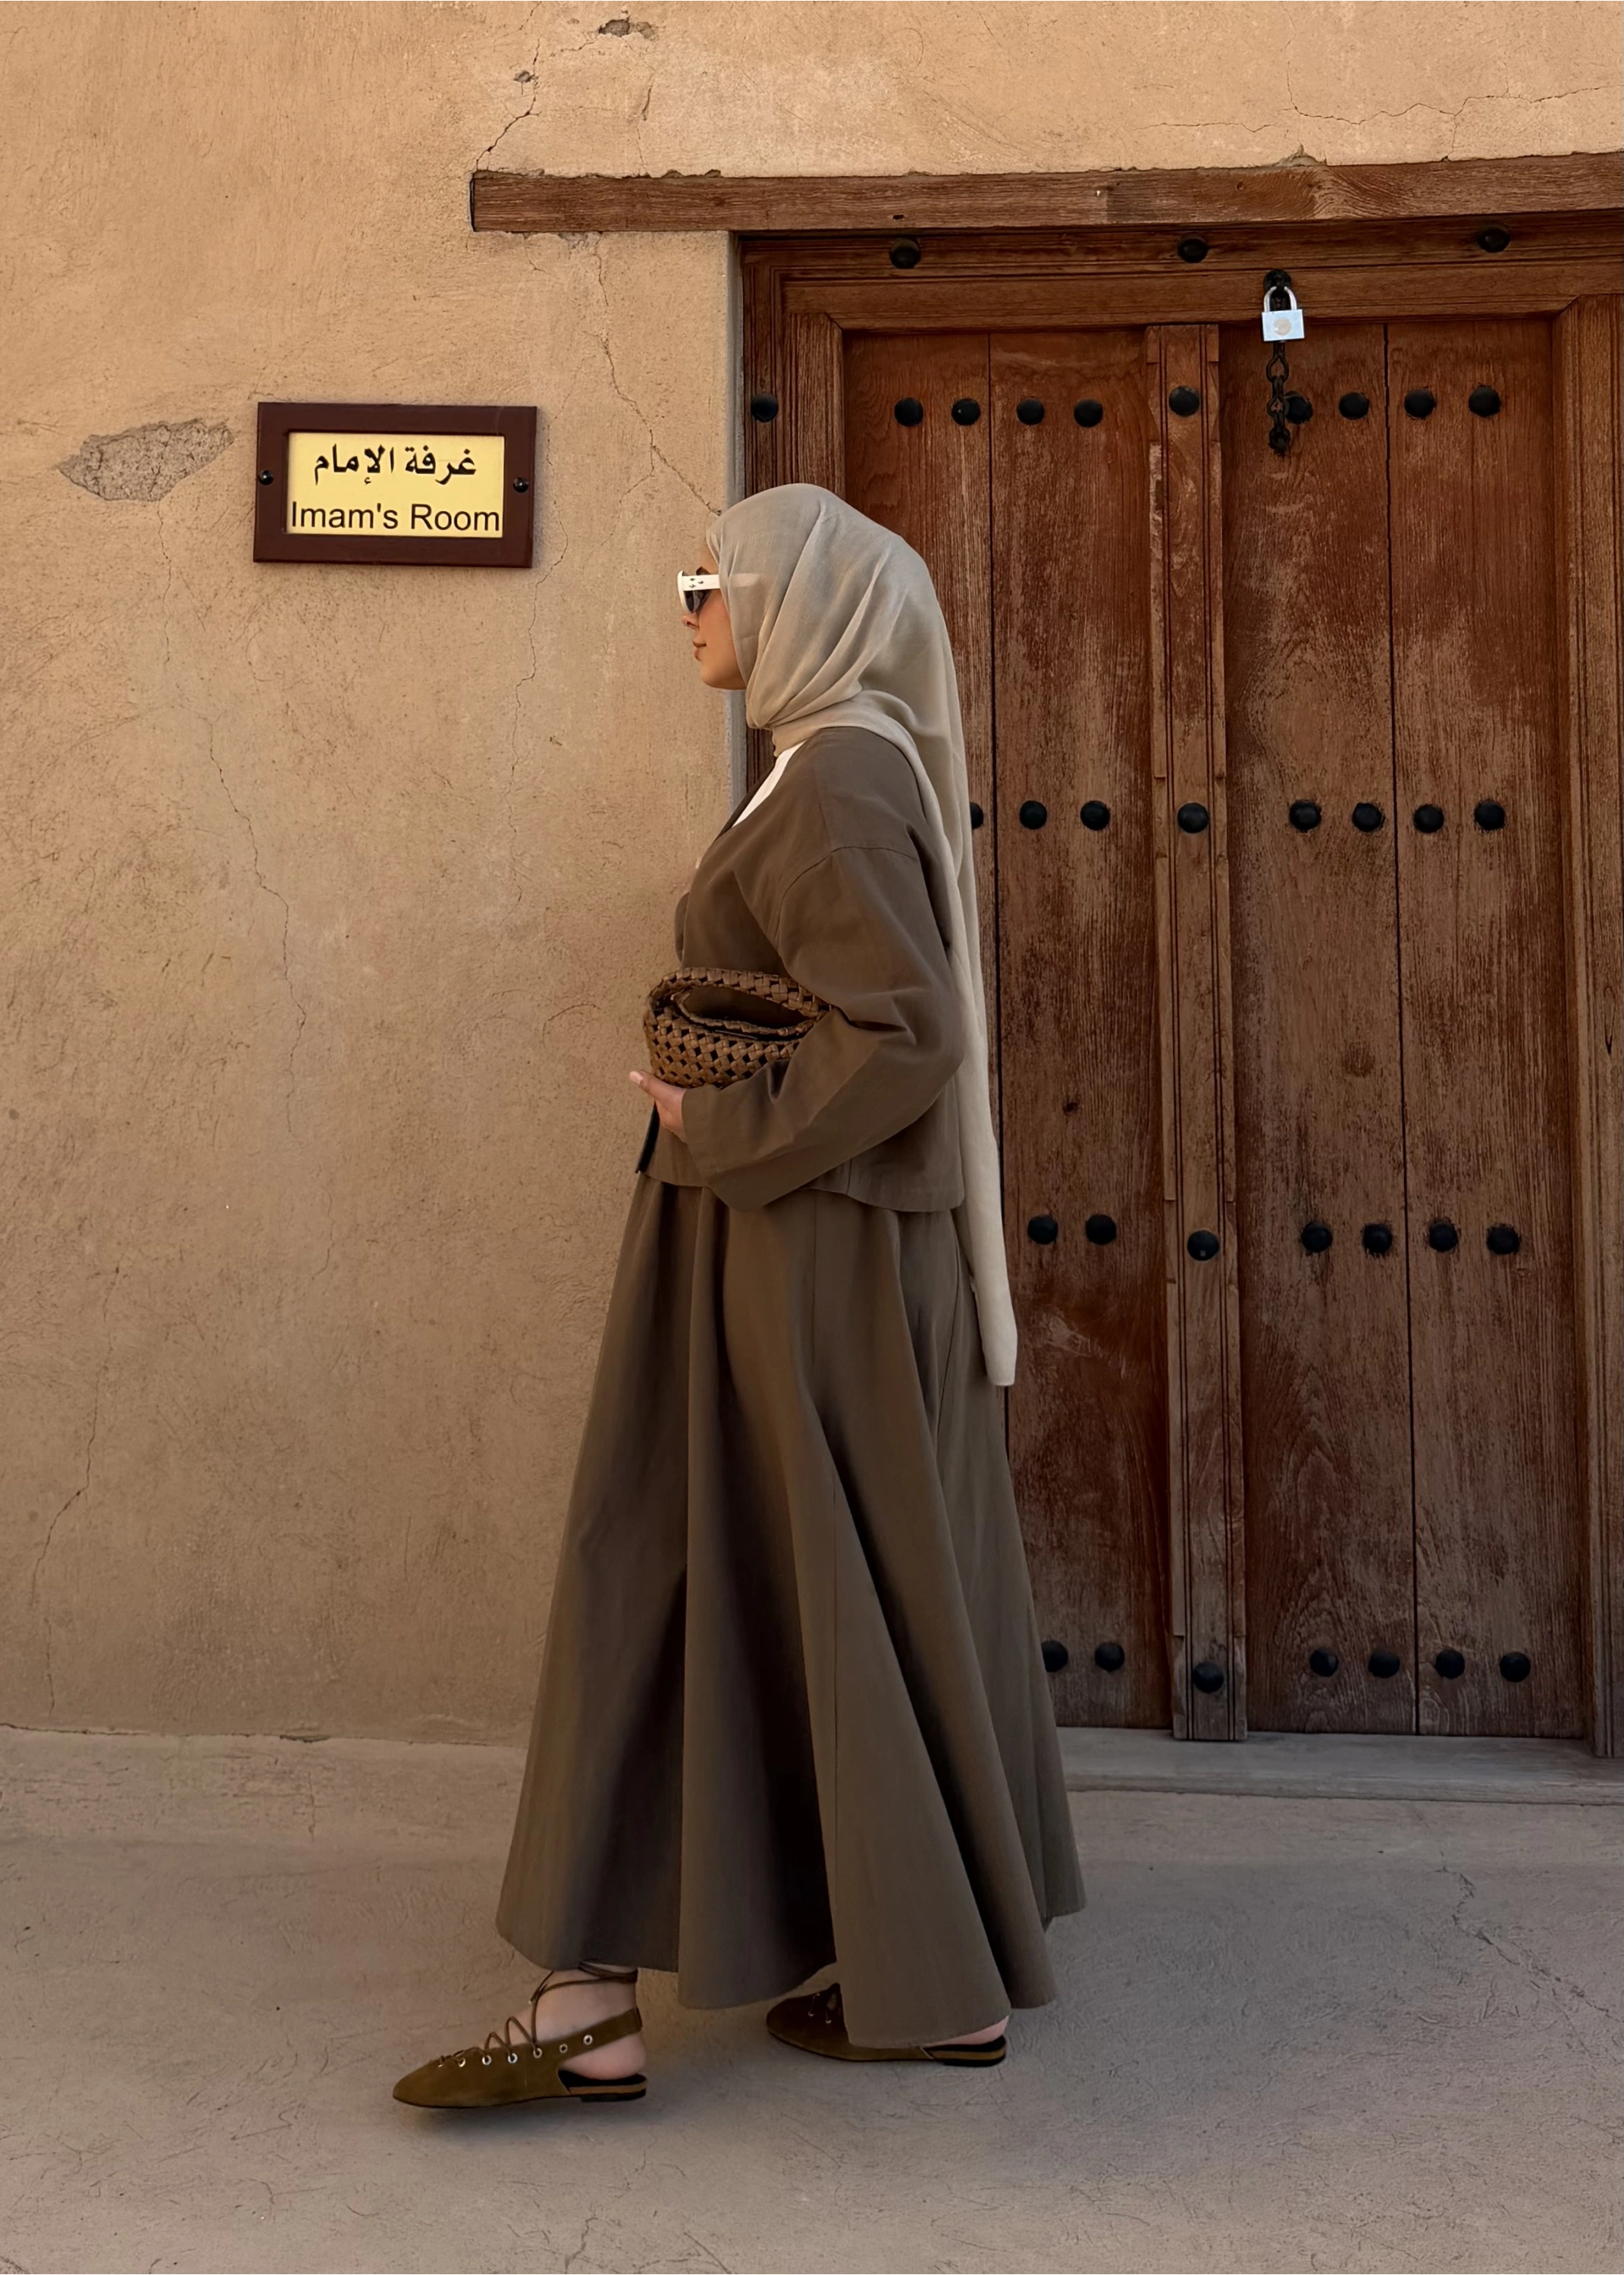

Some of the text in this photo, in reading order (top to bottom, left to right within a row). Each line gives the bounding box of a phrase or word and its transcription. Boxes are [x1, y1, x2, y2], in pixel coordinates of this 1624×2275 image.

[314, 443, 477, 485] غرفة الإمام
[292, 501, 500, 532] Imam's Room
